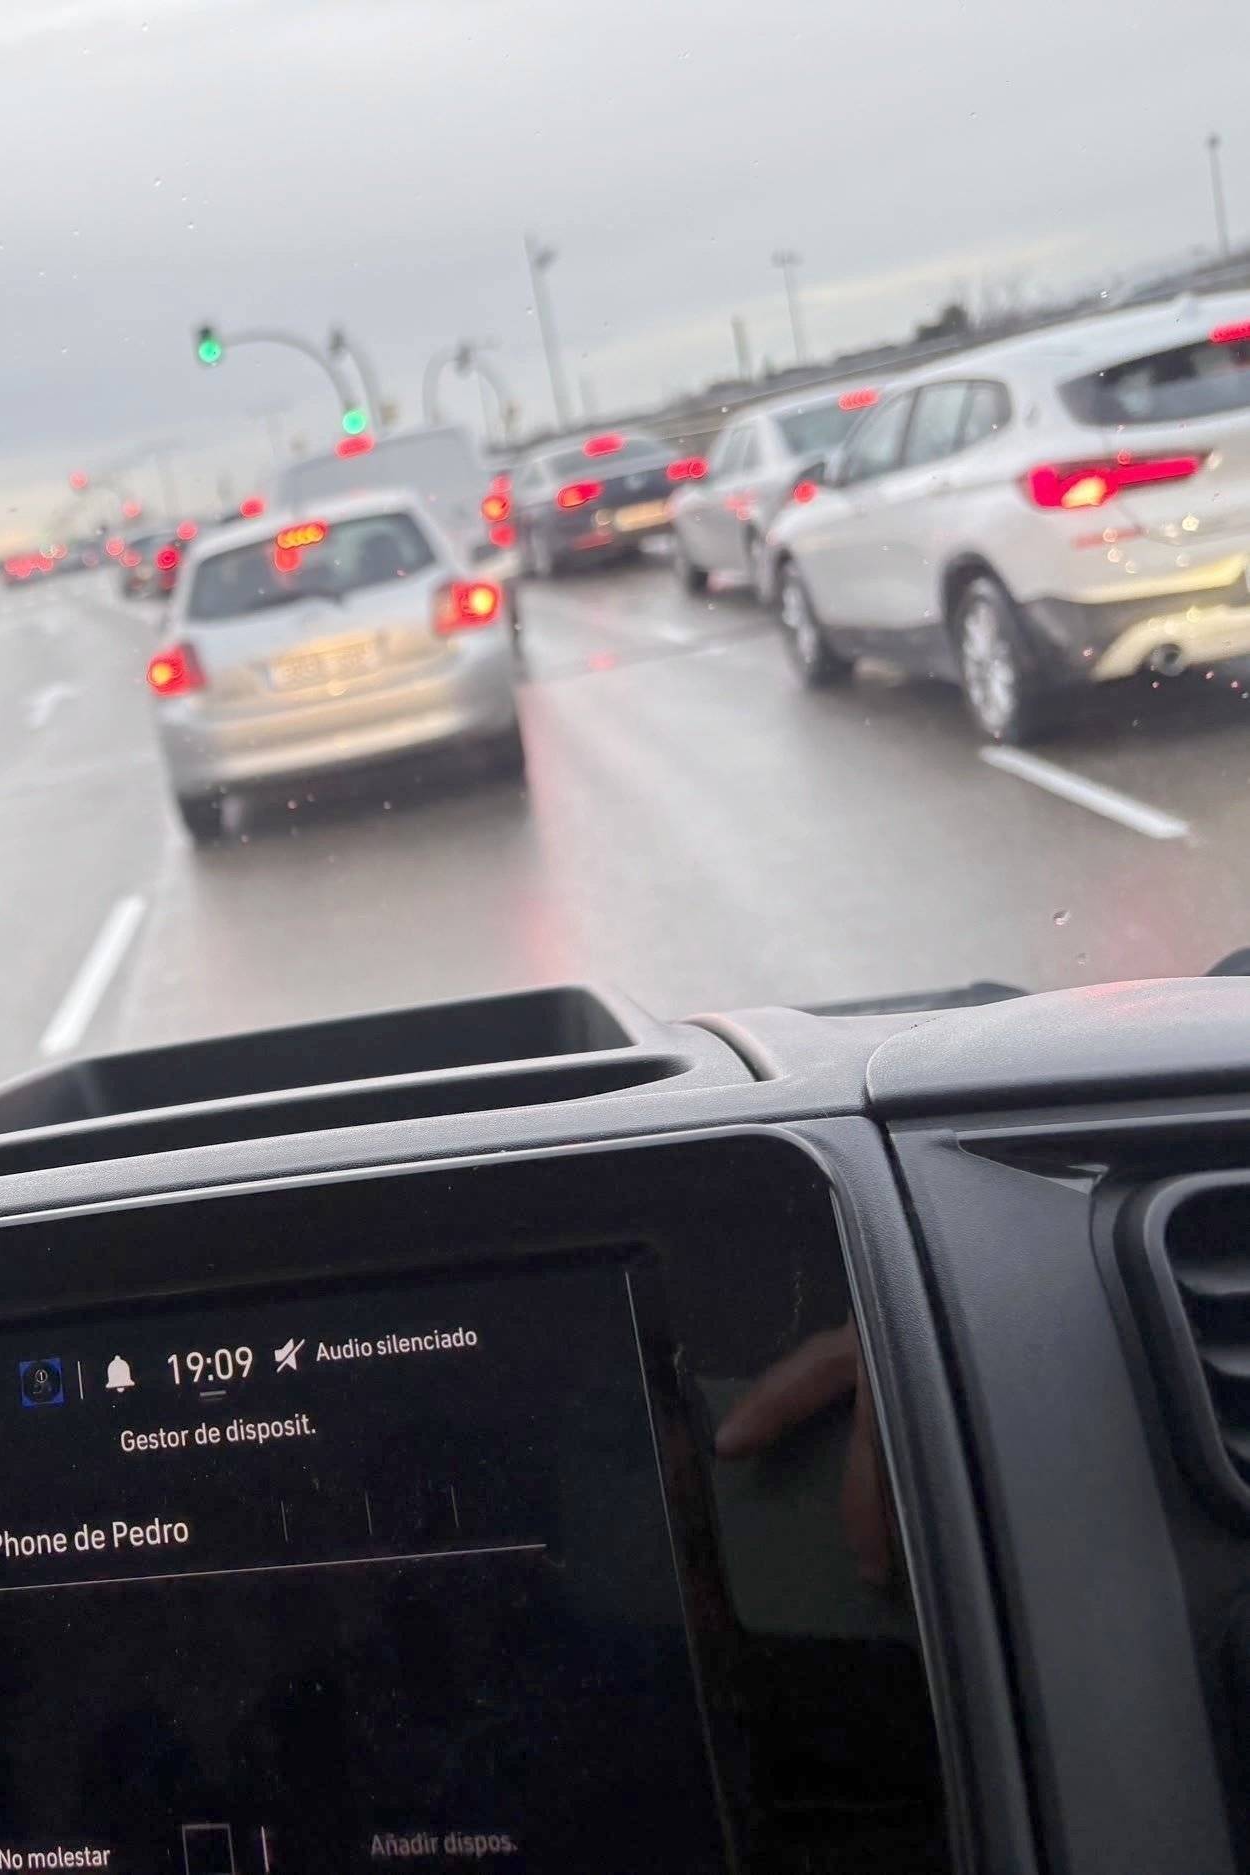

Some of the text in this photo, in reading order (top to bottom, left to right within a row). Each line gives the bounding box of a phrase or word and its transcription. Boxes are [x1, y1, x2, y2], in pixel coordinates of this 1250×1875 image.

[315, 1327, 478, 1362] Audio silenciado
[167, 1346, 253, 1385] 19:09
[120, 1413, 317, 1452] Gestor de disposit.
[74, 1523, 105, 1551] de
[112, 1517, 189, 1548] Pedro
[27, 1846, 111, 1869] molestar
[370, 1831, 519, 1858] Añadir dispos.
